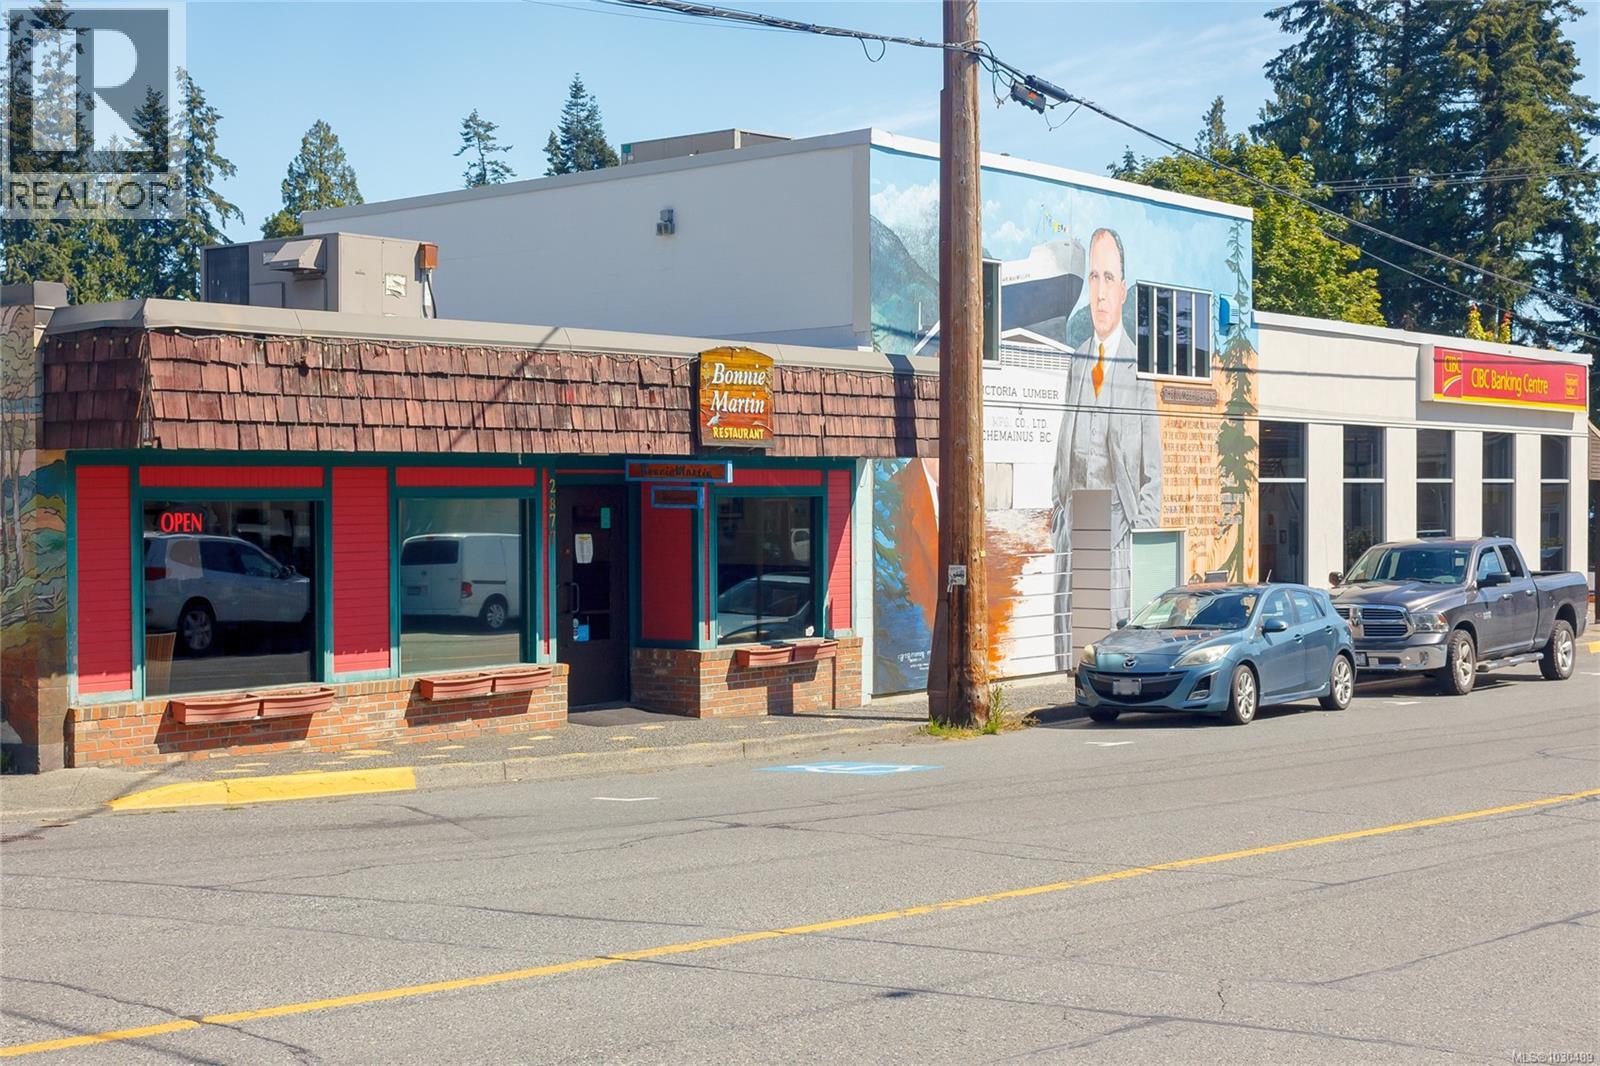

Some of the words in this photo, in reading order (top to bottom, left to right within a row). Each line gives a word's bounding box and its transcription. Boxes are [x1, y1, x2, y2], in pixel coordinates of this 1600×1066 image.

[712, 362, 766, 385] Bonnie
[1444, 355, 1462, 373] CIBC
[983, 385, 1018, 397] CTORIA
[1022, 388, 1059, 400] LUMBER
[1471, 367, 1490, 389] CIBC
[1491, 370, 1522, 397] Banking
[1523, 373, 1549, 395] Centre
[710, 390, 765, 414] Martin
[712, 426, 765, 440] RESTAURANT
[160, 511, 203, 533] OPEN
